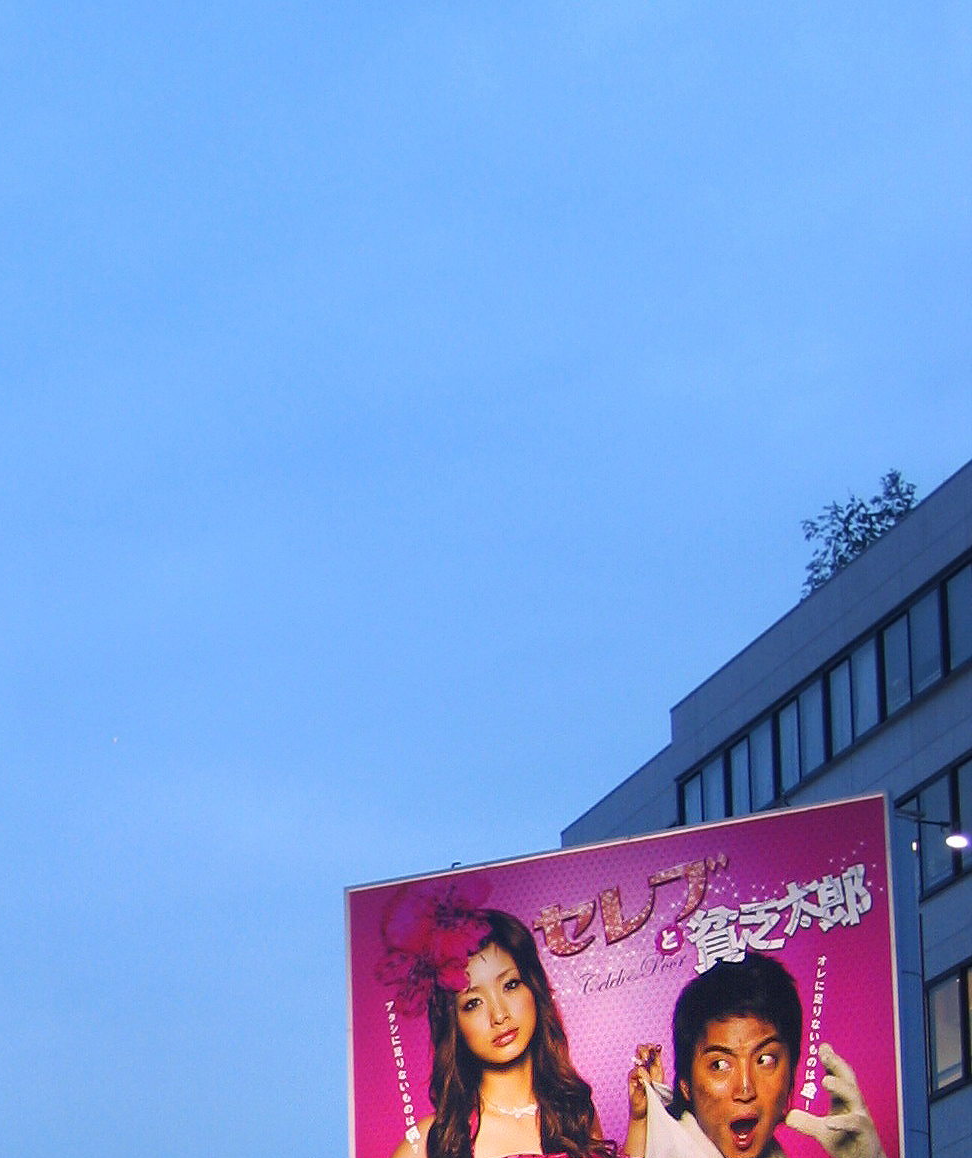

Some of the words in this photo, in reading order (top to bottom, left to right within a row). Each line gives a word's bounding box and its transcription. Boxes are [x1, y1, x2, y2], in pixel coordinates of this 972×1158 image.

[532, 852, 729, 957] セレブ
[685, 863, 873, 976] 貧乏太郎
